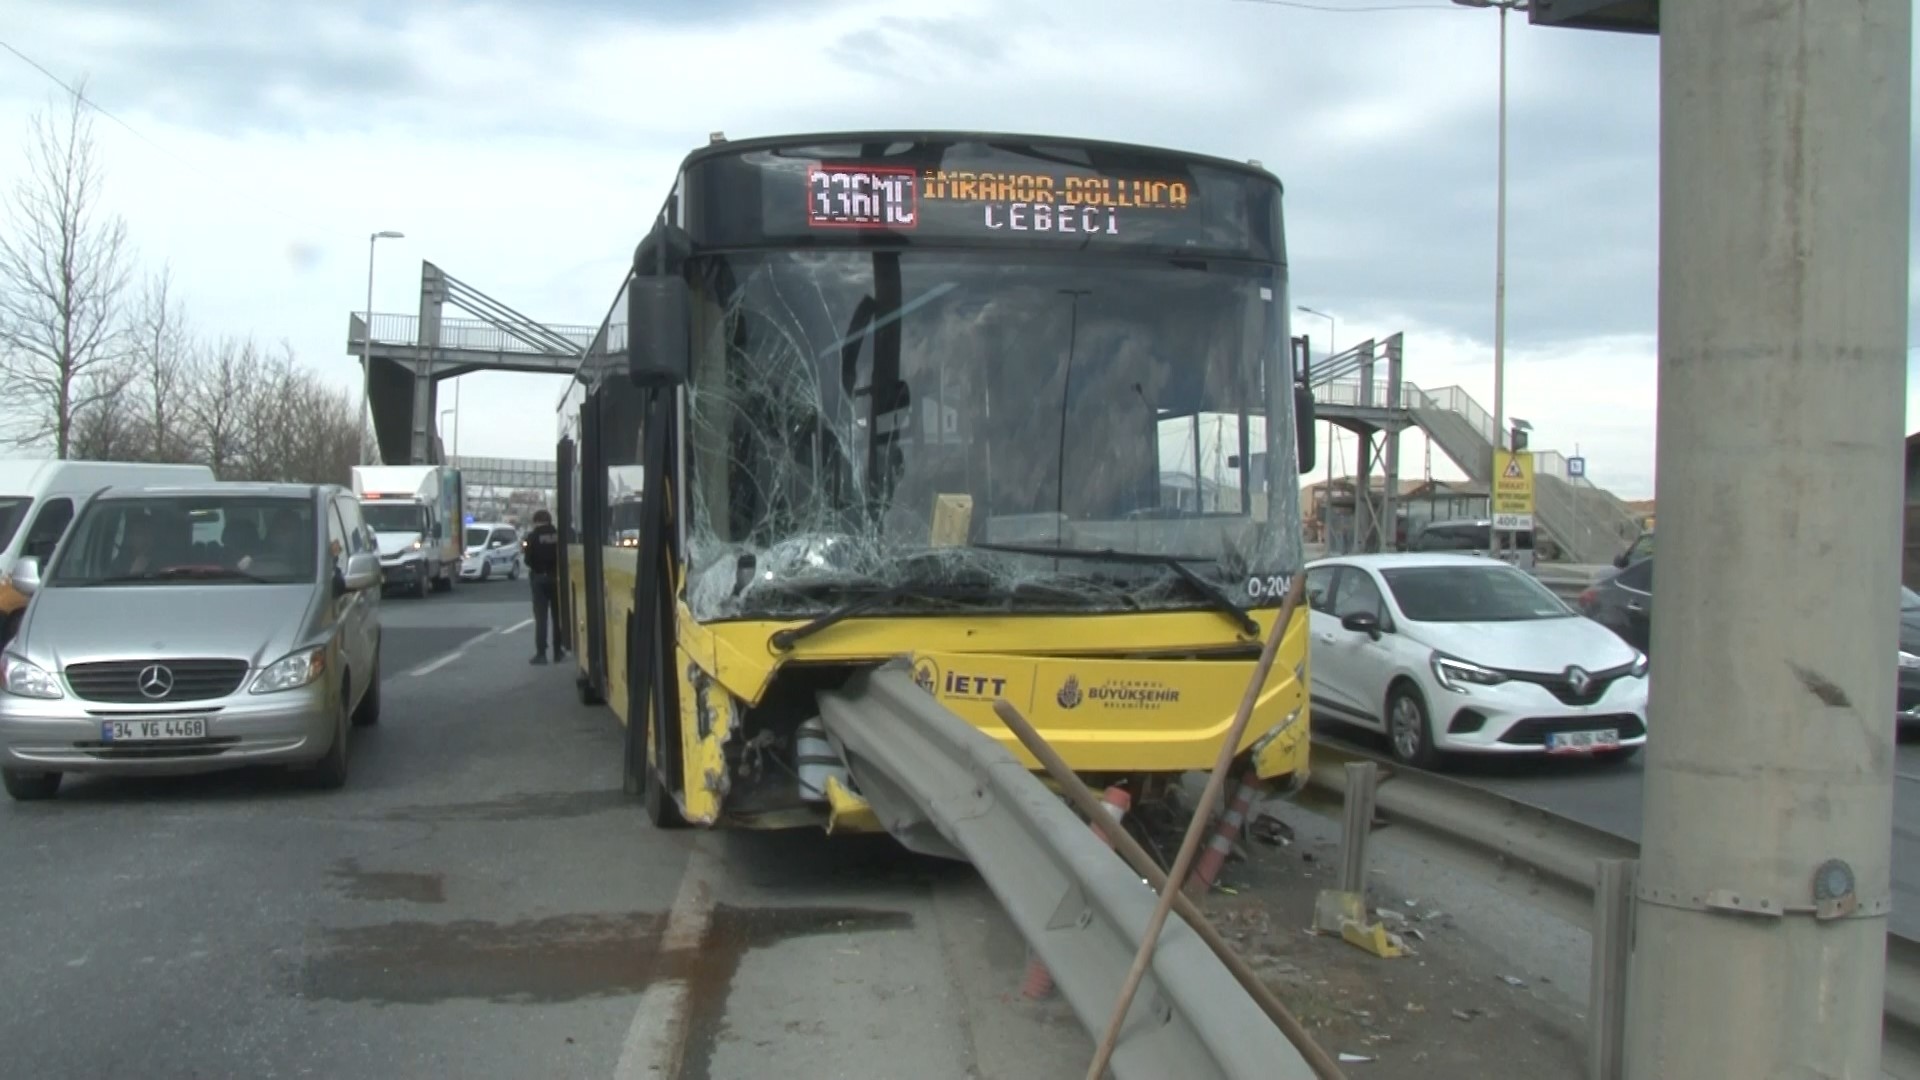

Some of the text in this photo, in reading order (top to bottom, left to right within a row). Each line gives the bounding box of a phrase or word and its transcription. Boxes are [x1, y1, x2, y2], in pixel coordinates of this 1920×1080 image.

[1497, 516, 1517, 526] 400
[945, 671, 1007, 696] İETT
[1088, 686, 1181, 704] BÜYÜKŞEHİR
[114, 722, 132, 738] 34
[141, 721, 159, 736] VG
